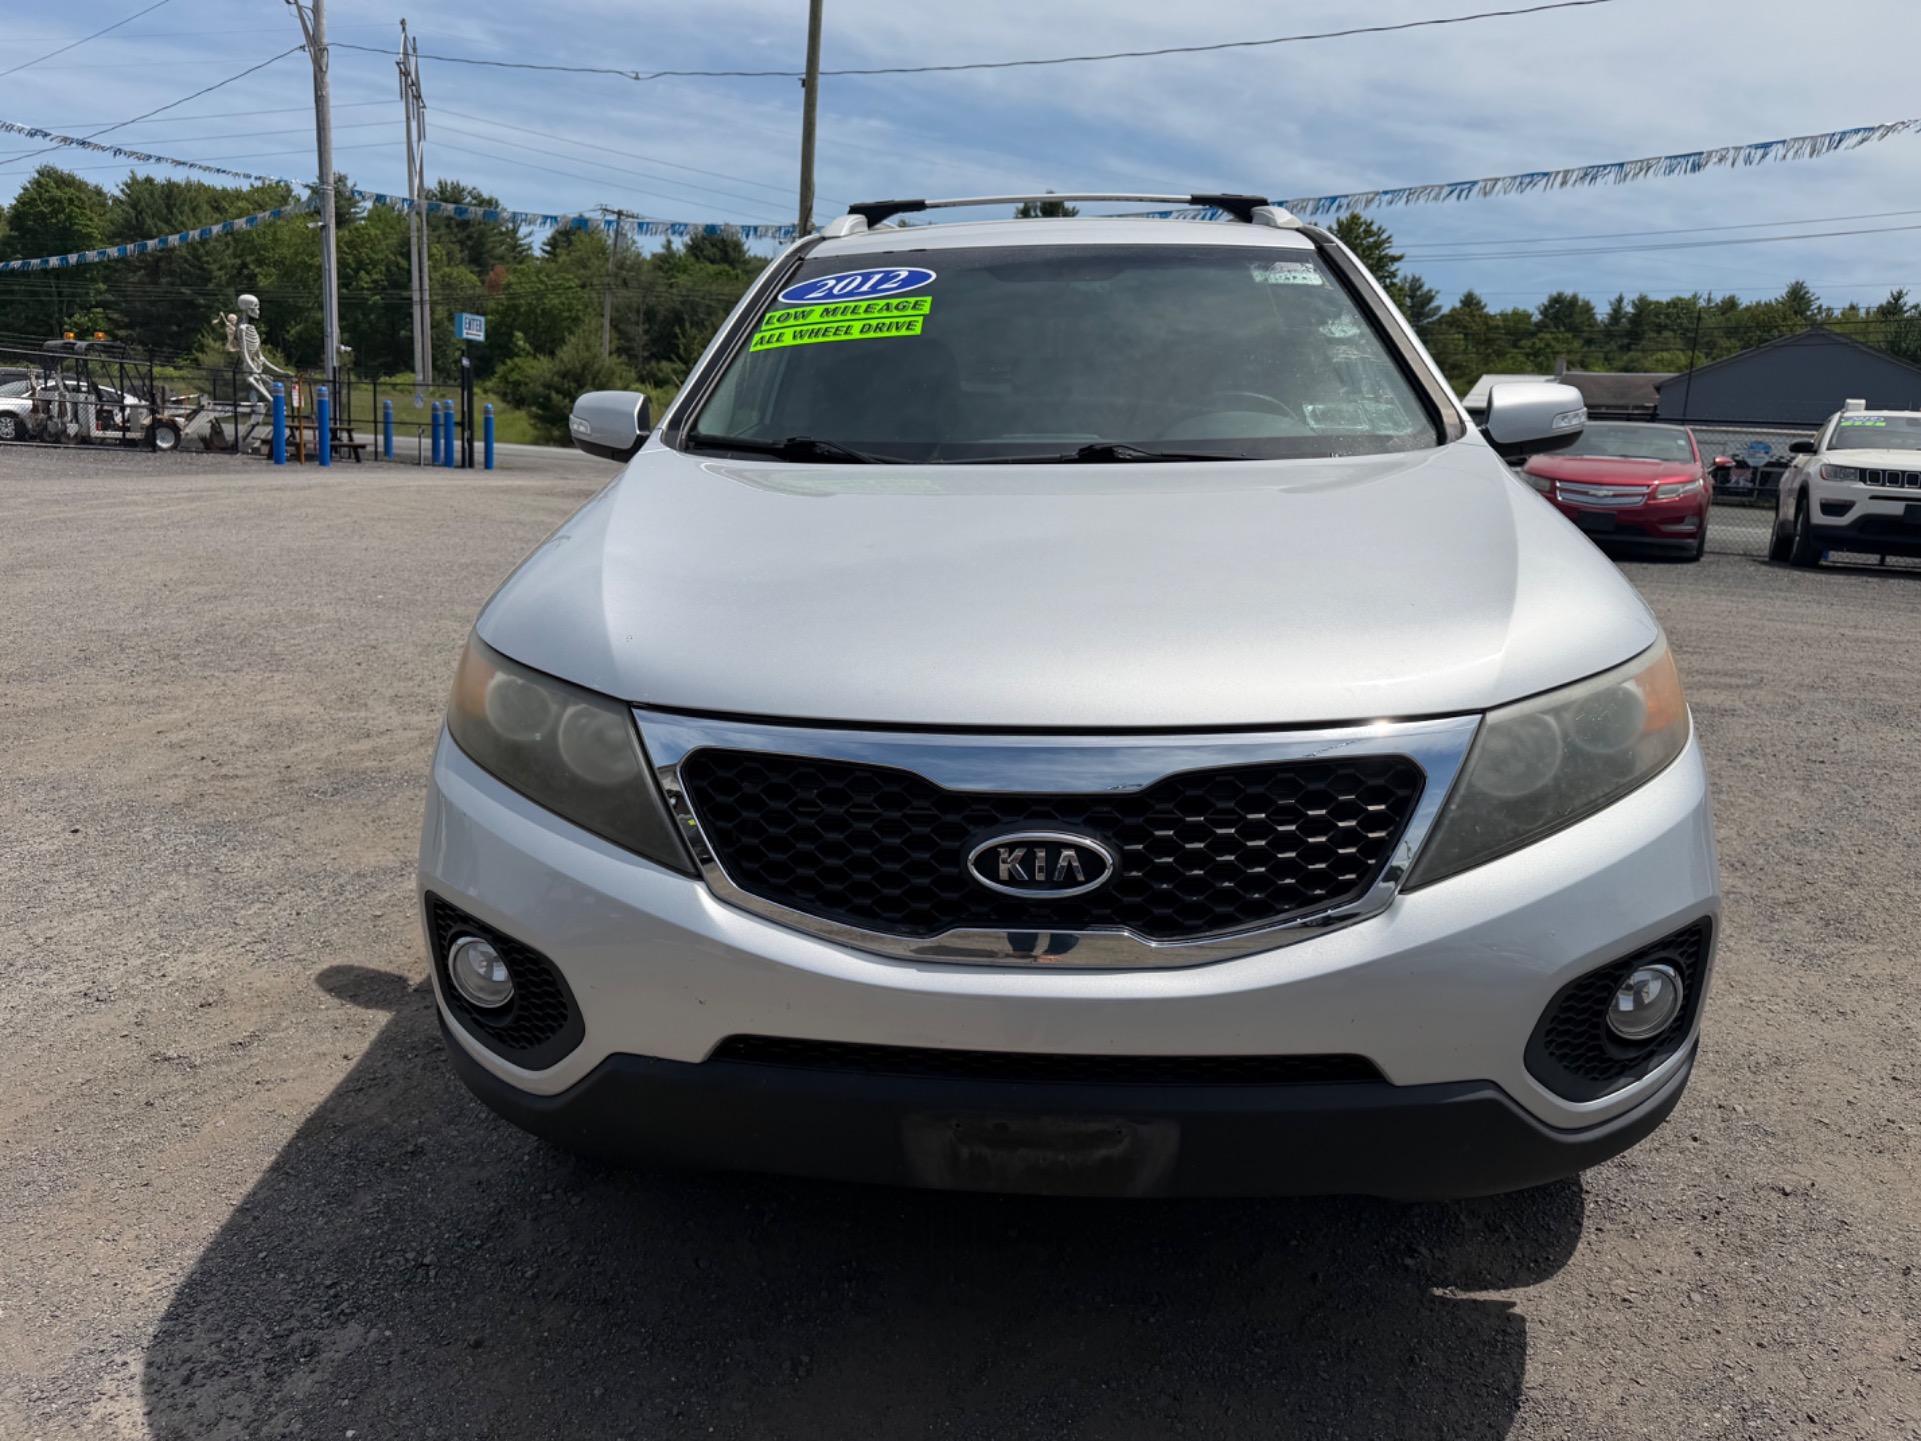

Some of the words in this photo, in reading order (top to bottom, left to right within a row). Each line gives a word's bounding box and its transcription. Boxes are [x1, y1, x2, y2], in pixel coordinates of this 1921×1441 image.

[803, 270, 909, 299] 2012
[464, 316, 483, 332] ENTER
[764, 309, 815, 327] LOW
[819, 299, 928, 318] MILEAGE
[752, 331, 785, 348] ALL
[792, 323, 855, 341] WHEEL
[859, 319, 919, 335] DRIVE
[997, 848, 1085, 881] KIA
